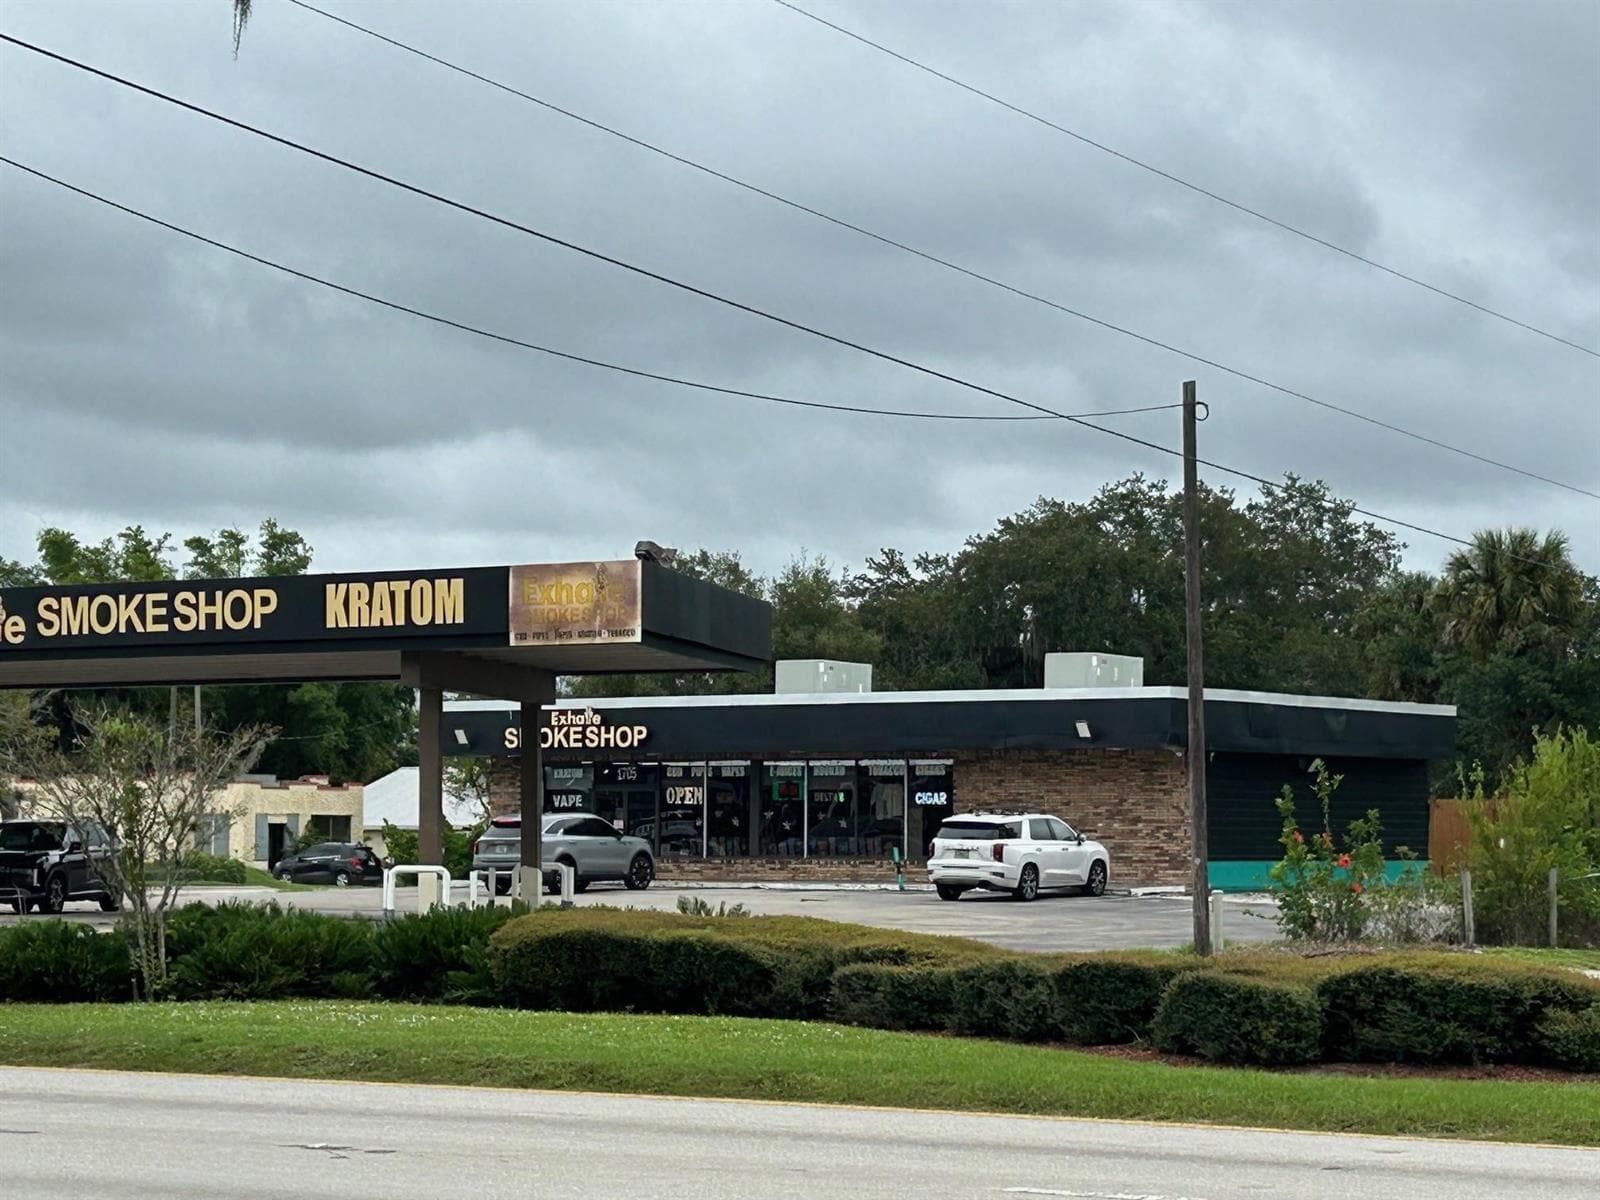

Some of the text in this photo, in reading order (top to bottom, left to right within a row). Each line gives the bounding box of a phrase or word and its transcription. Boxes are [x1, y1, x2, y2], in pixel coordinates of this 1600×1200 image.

[325, 577, 464, 629] KRATOM
[504, 726, 583, 748] SOKE
[552, 794, 584, 808] VAPE
[665, 786, 704, 805] OPEN
[914, 791, 948, 805] CIGAR
